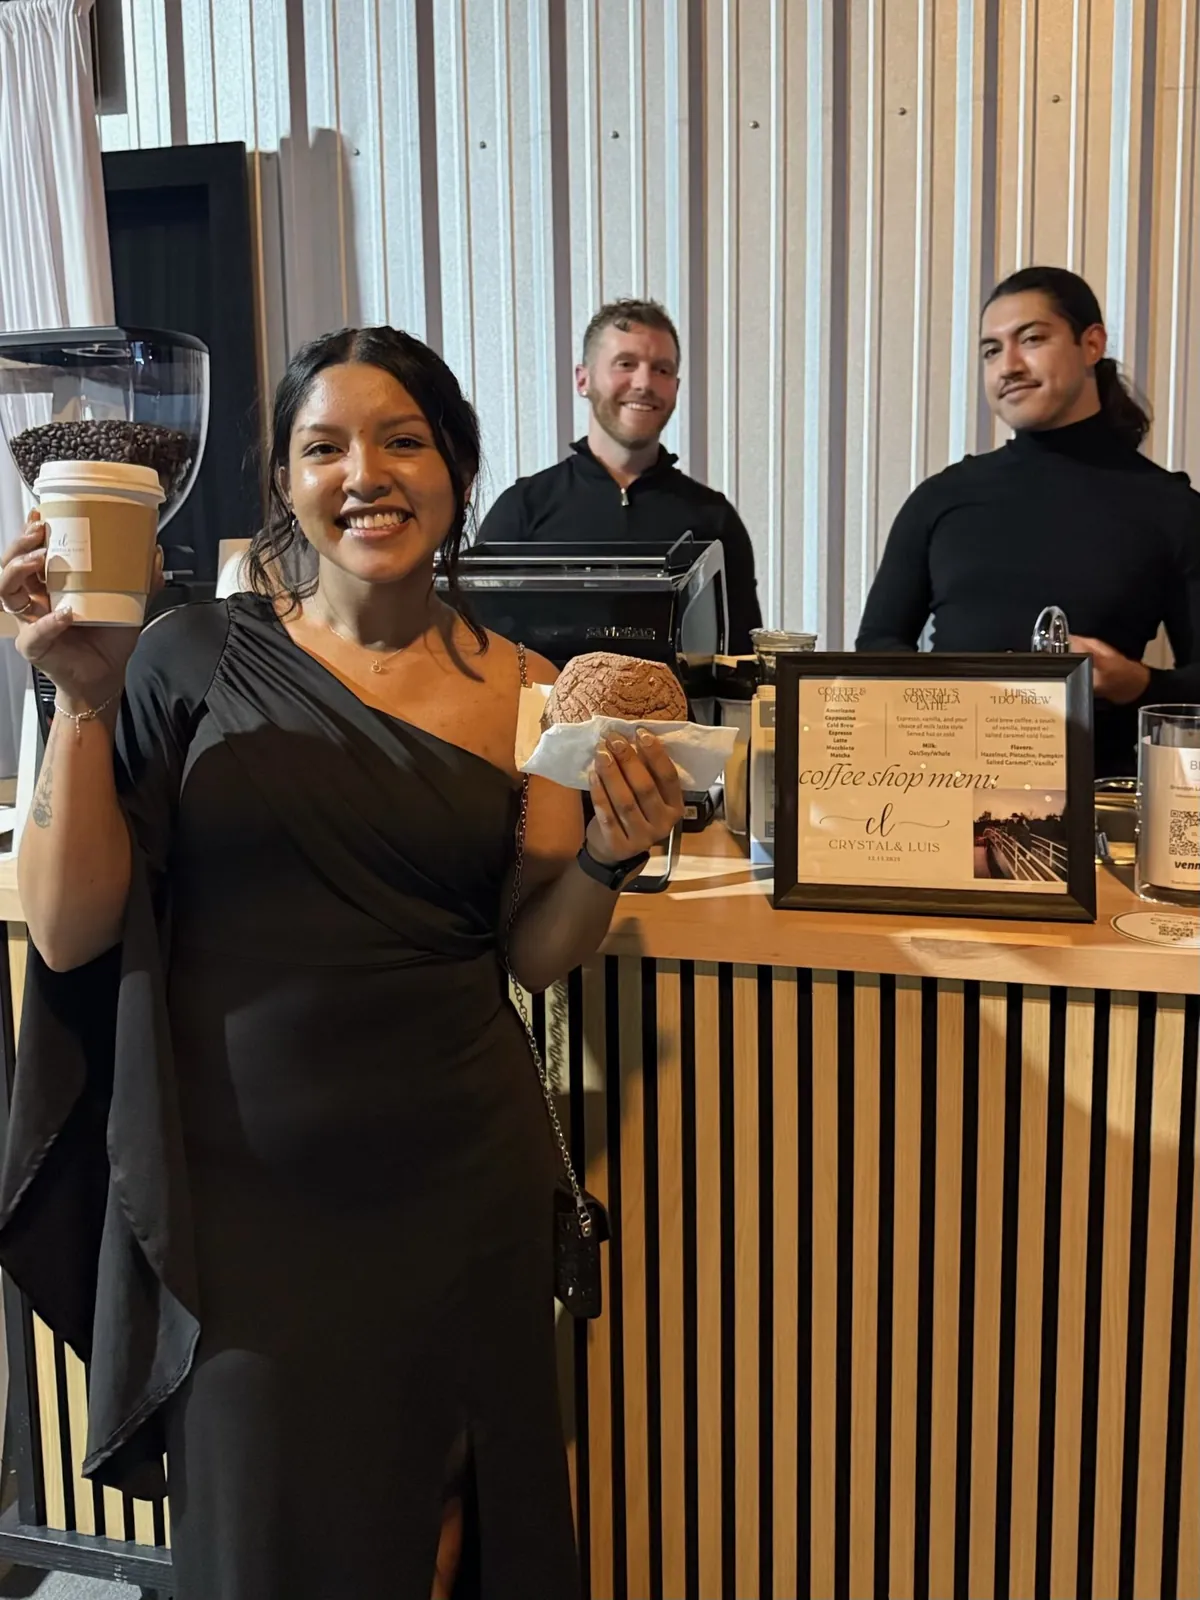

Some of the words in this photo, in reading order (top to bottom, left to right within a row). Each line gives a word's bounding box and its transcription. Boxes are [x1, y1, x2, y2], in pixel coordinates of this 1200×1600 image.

[817, 686, 858, 696] COFFEE
[859, 687, 866, 695] &
[904, 687, 960, 696] CRYSTAL'S
[824, 694, 860, 703] DRINKS
[916, 701, 948, 711] LATTE
[799, 763, 865, 790] coffee
[867, 764, 926, 794] shop
[928, 772, 1000, 790] menu
[908, 842, 941, 853] LUIS
